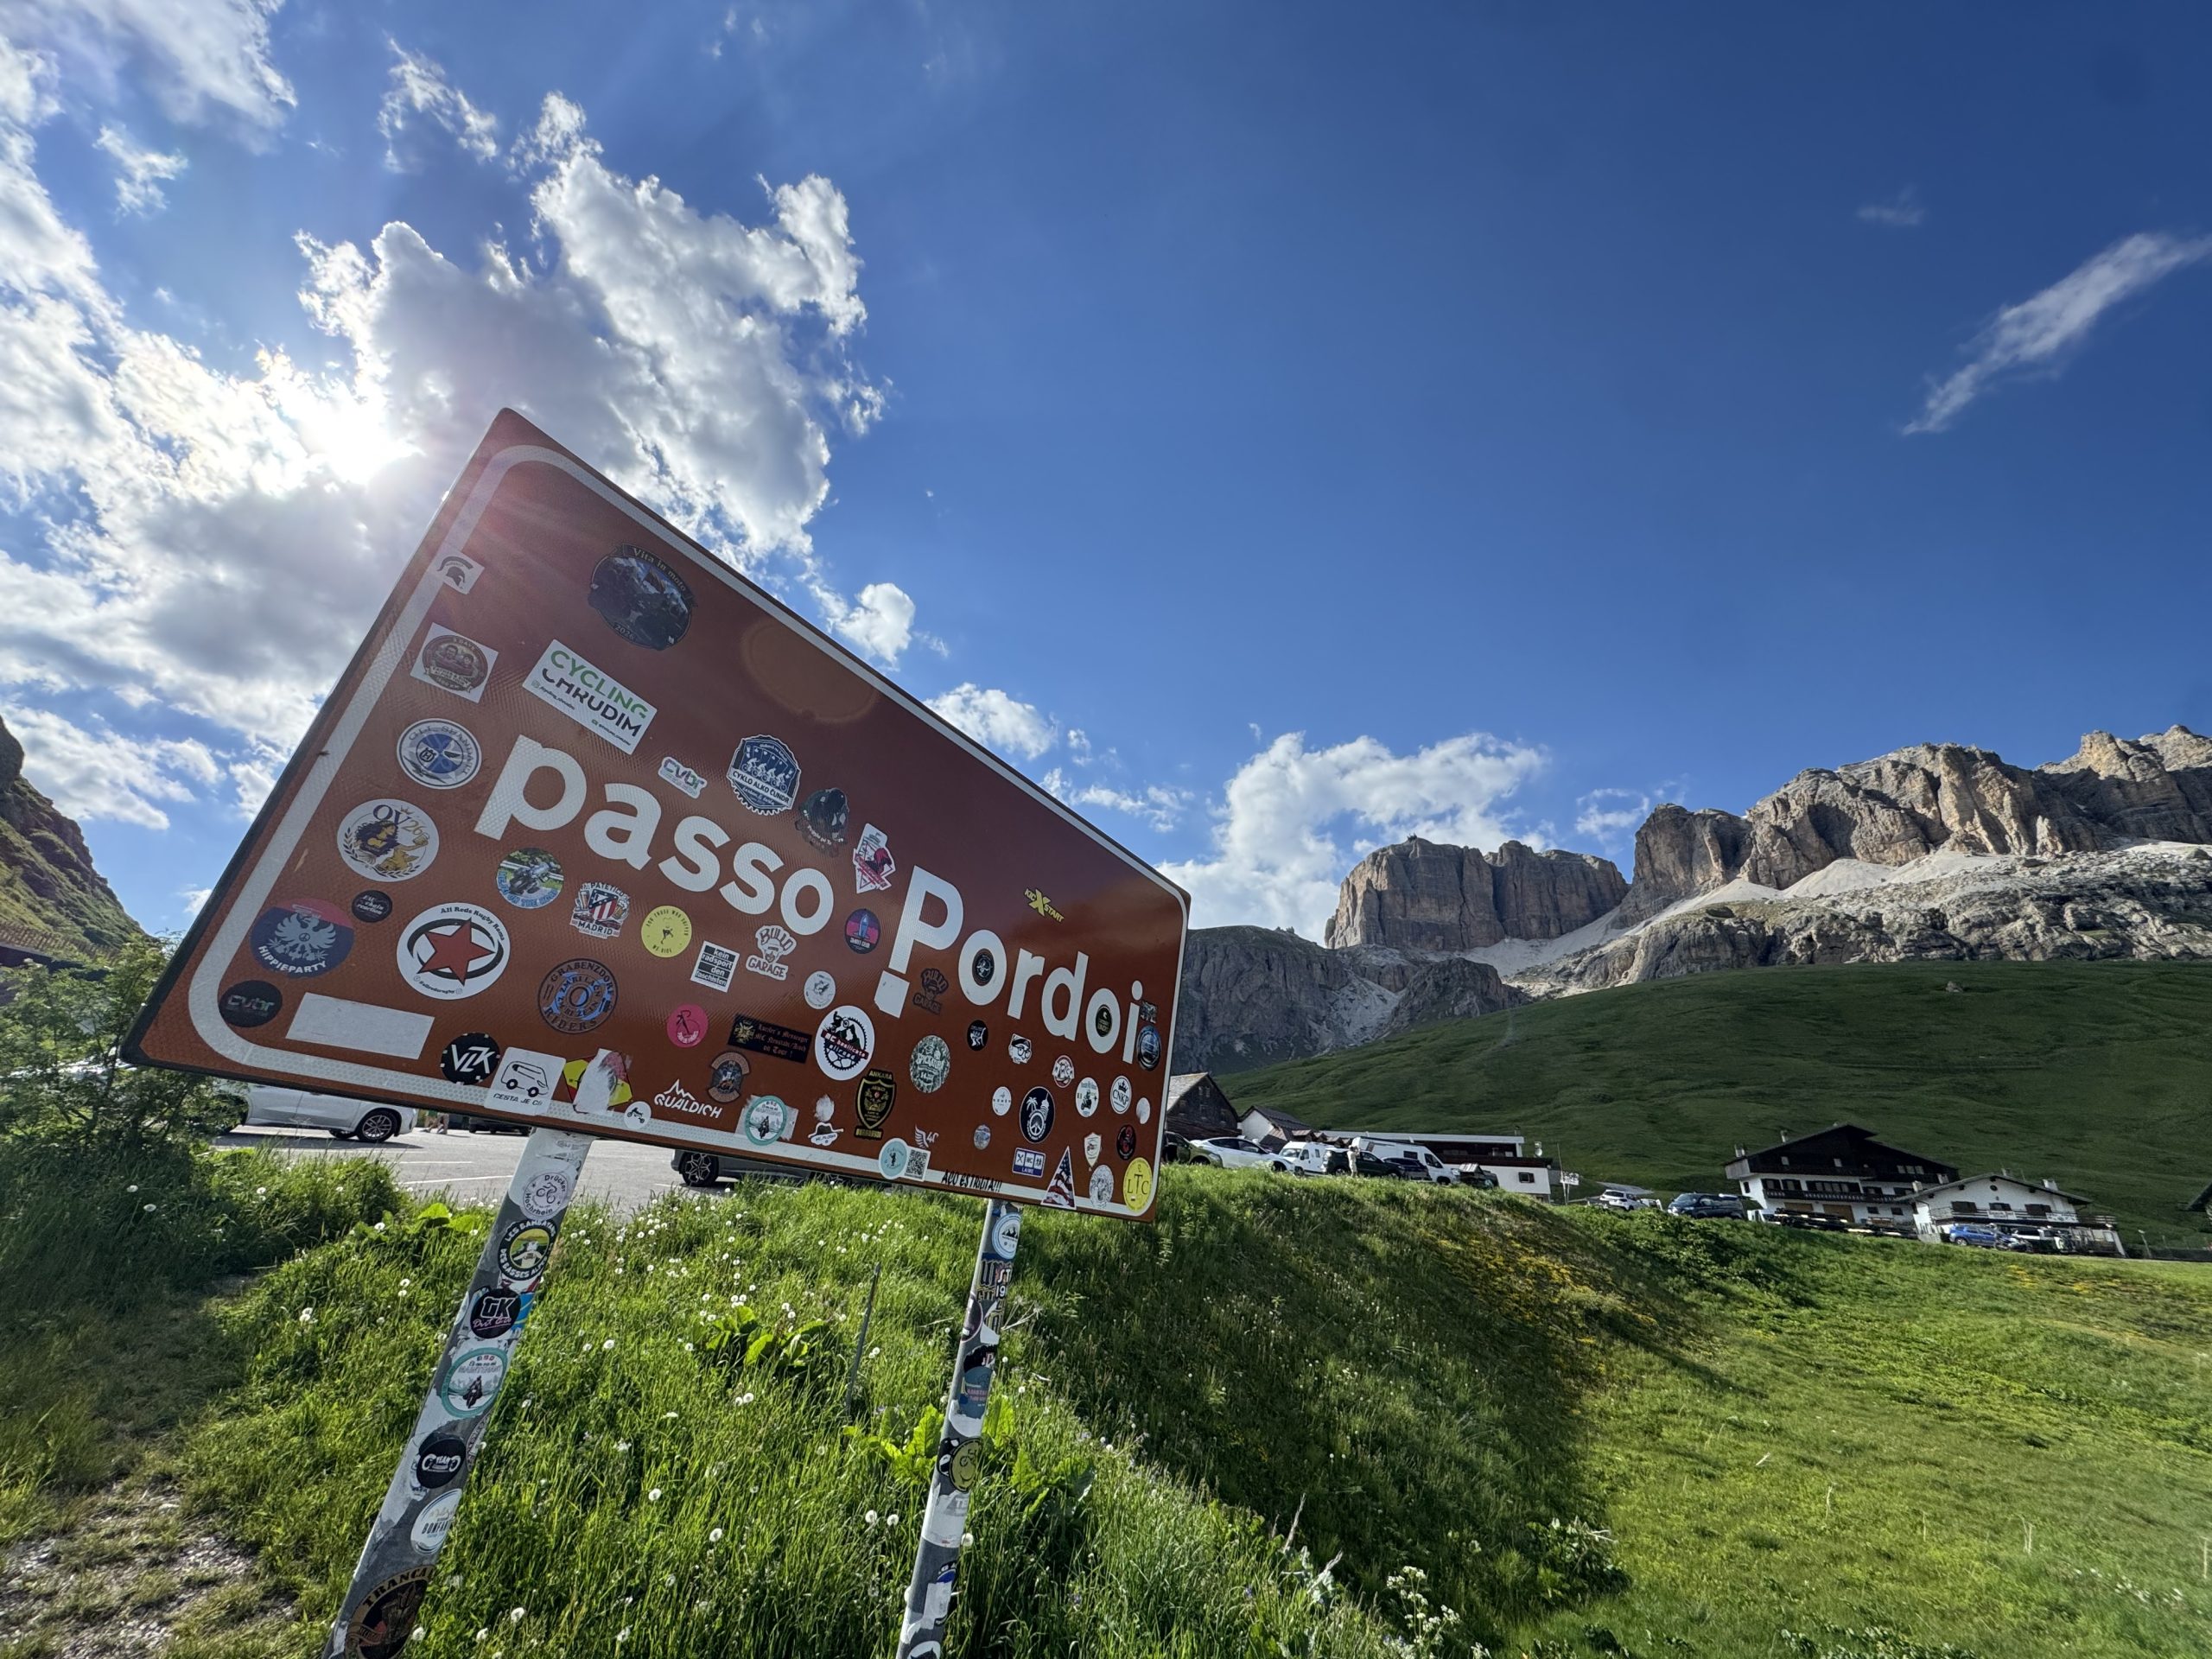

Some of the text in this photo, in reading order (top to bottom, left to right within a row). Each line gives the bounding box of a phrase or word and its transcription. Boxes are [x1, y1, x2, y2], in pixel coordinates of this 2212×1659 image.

[550, 650, 648, 719] CYCLING
[542, 668, 642, 737] CHRUDIM
[733, 771, 753, 785] CYKLO
[753, 781, 770, 793] ALKO
[475, 734, 1142, 1065] passo Pordoi
[578, 920, 613, 935] MADRID
[258, 945, 327, 973] HIPPIEPARTY
[710, 966, 725, 976] den
[748, 957, 786, 977] GARAGE
[544, 1007, 598, 1031] RIDERS
[493, 1093, 518, 1103] CESTA
[653, 1093, 722, 1119] QUALDICH
[544, 1174, 566, 1192] Drücker
[525, 1192, 553, 1216] Hochrhein
